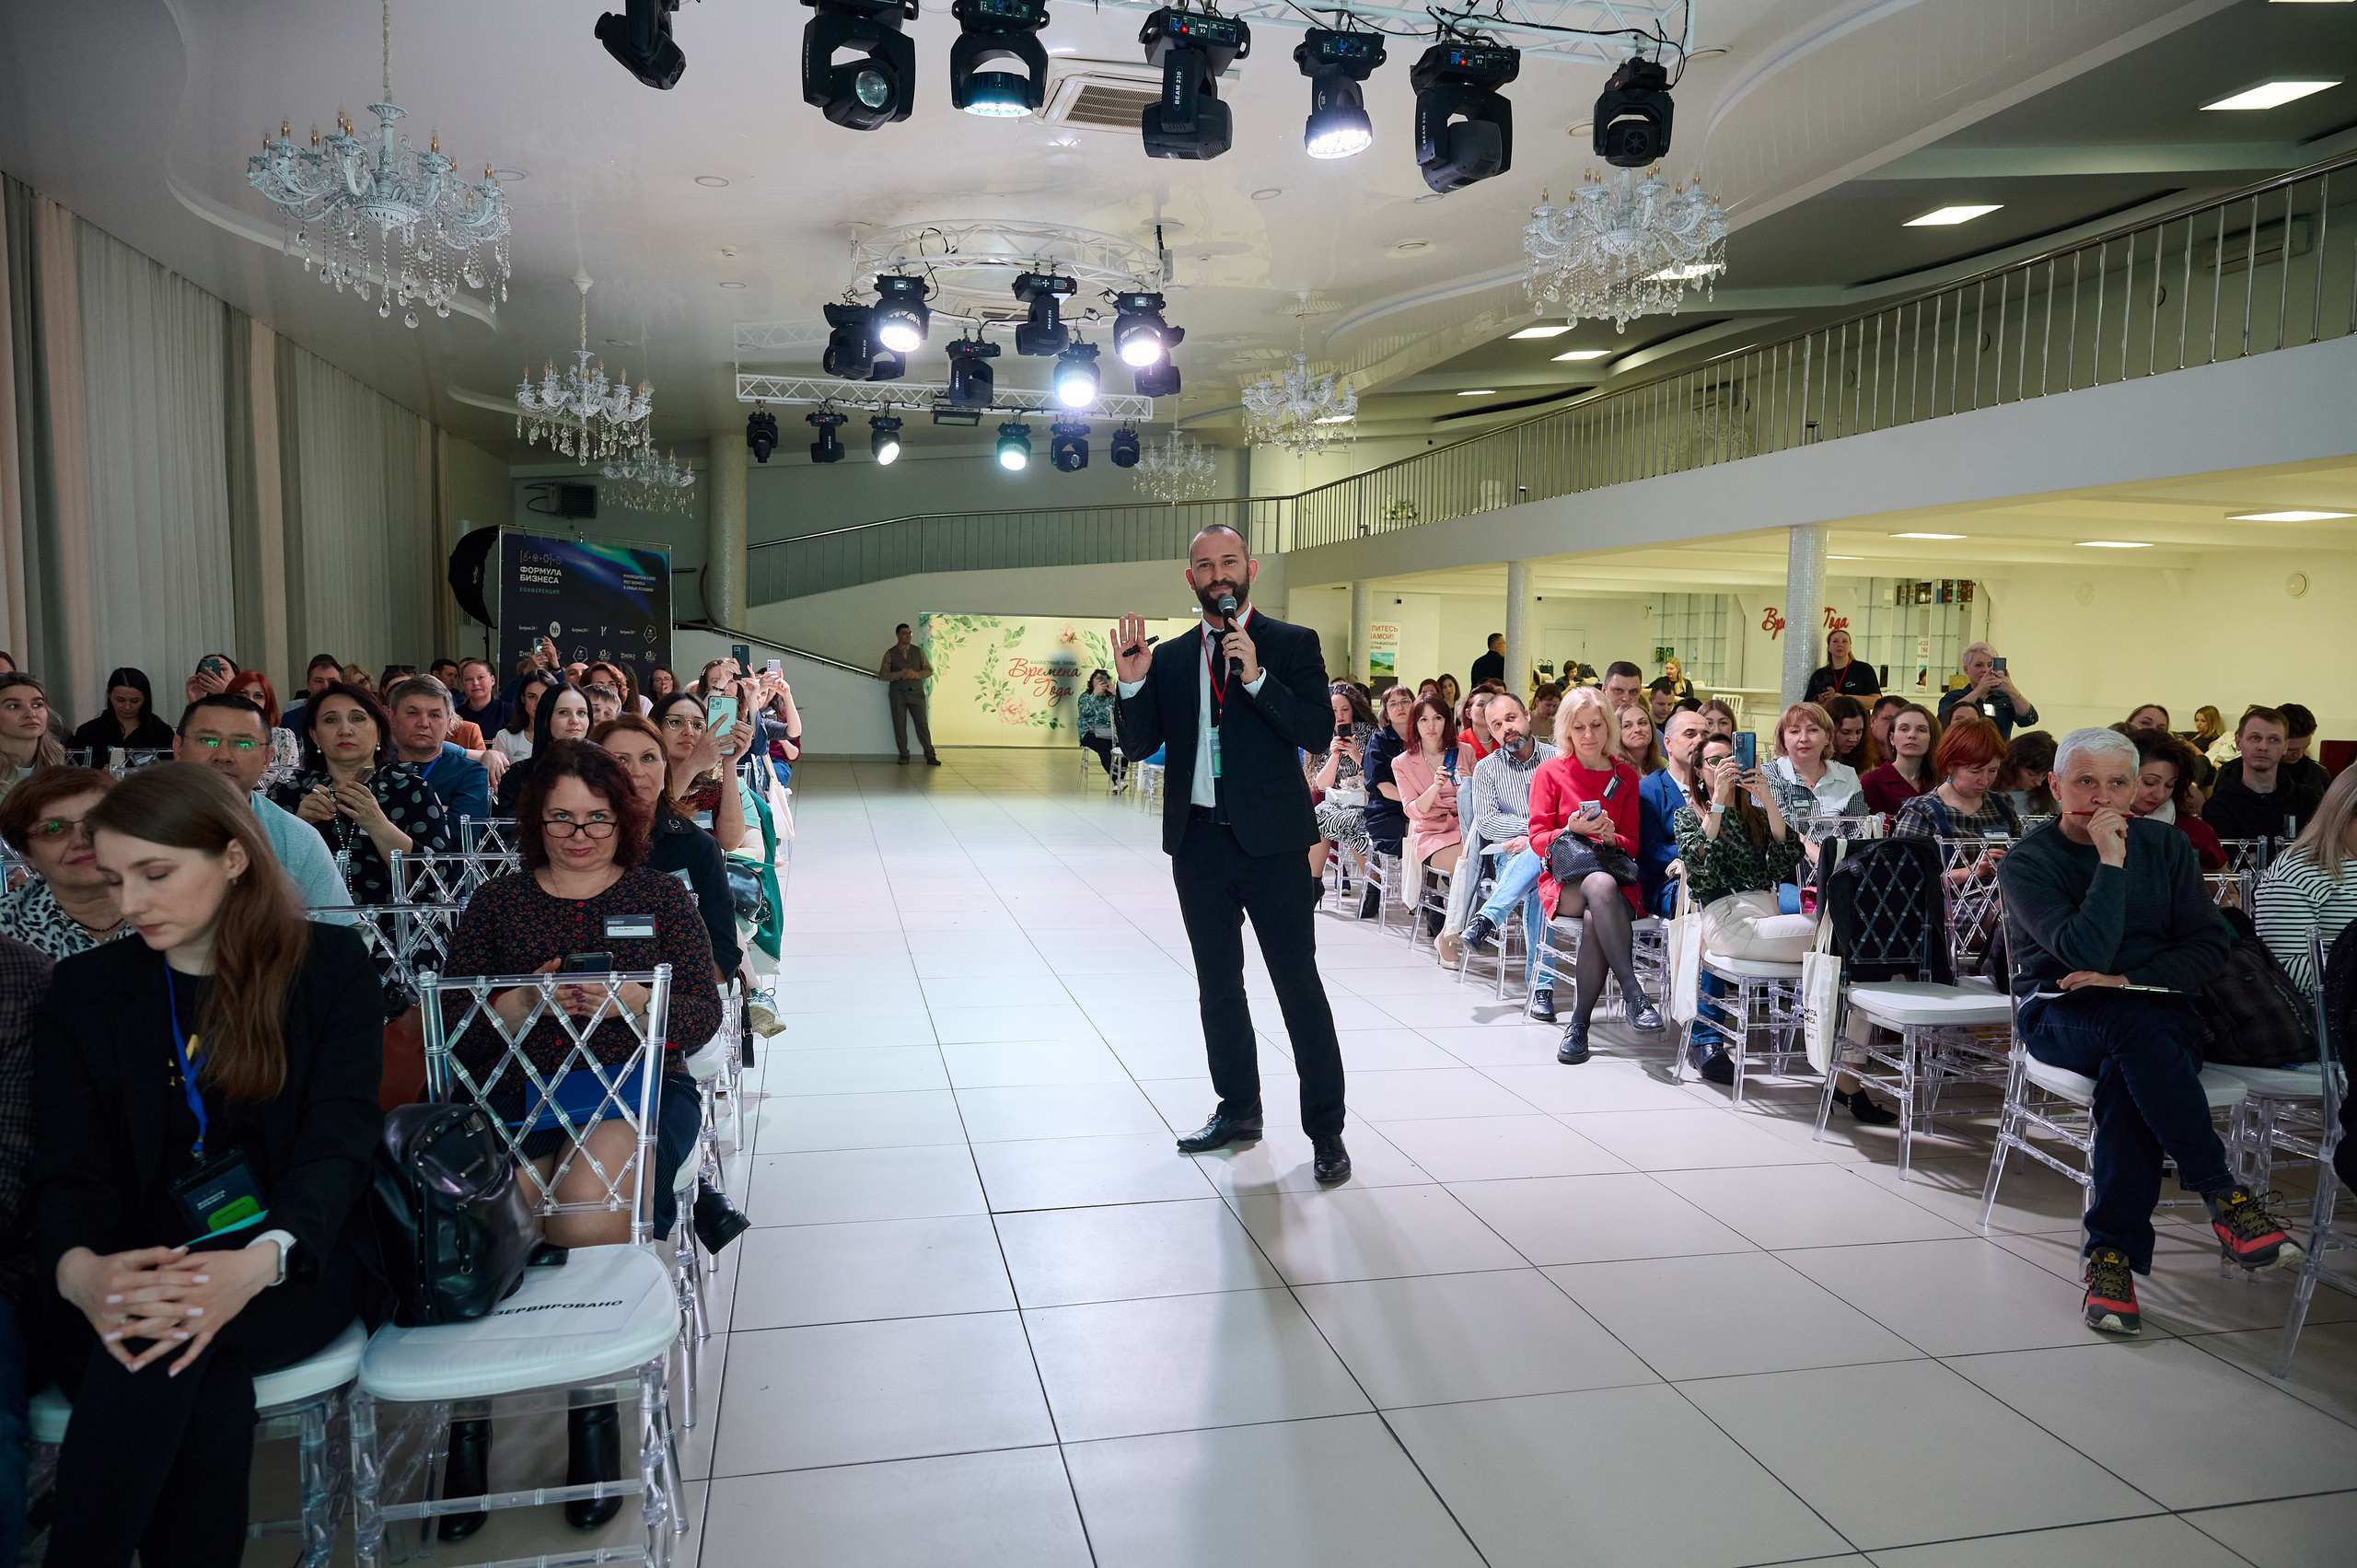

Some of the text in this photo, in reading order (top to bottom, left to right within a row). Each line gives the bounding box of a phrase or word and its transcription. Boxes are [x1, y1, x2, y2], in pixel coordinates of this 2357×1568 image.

[519, 565, 563, 577] ФОРМУЛА
[519, 574, 560, 585] БИЗНЕСА
[519, 587, 560, 595] КОНФЕРЕНЦИЯ
[551, 625, 559, 633] hh
[1371, 624, 1399, 633] ЛИТЕСЬ
[1008, 657, 1082, 685] Времена
[1033, 678, 1074, 707] Года
[487, 1300, 623, 1317] ЗЕРВИРОВАНО
